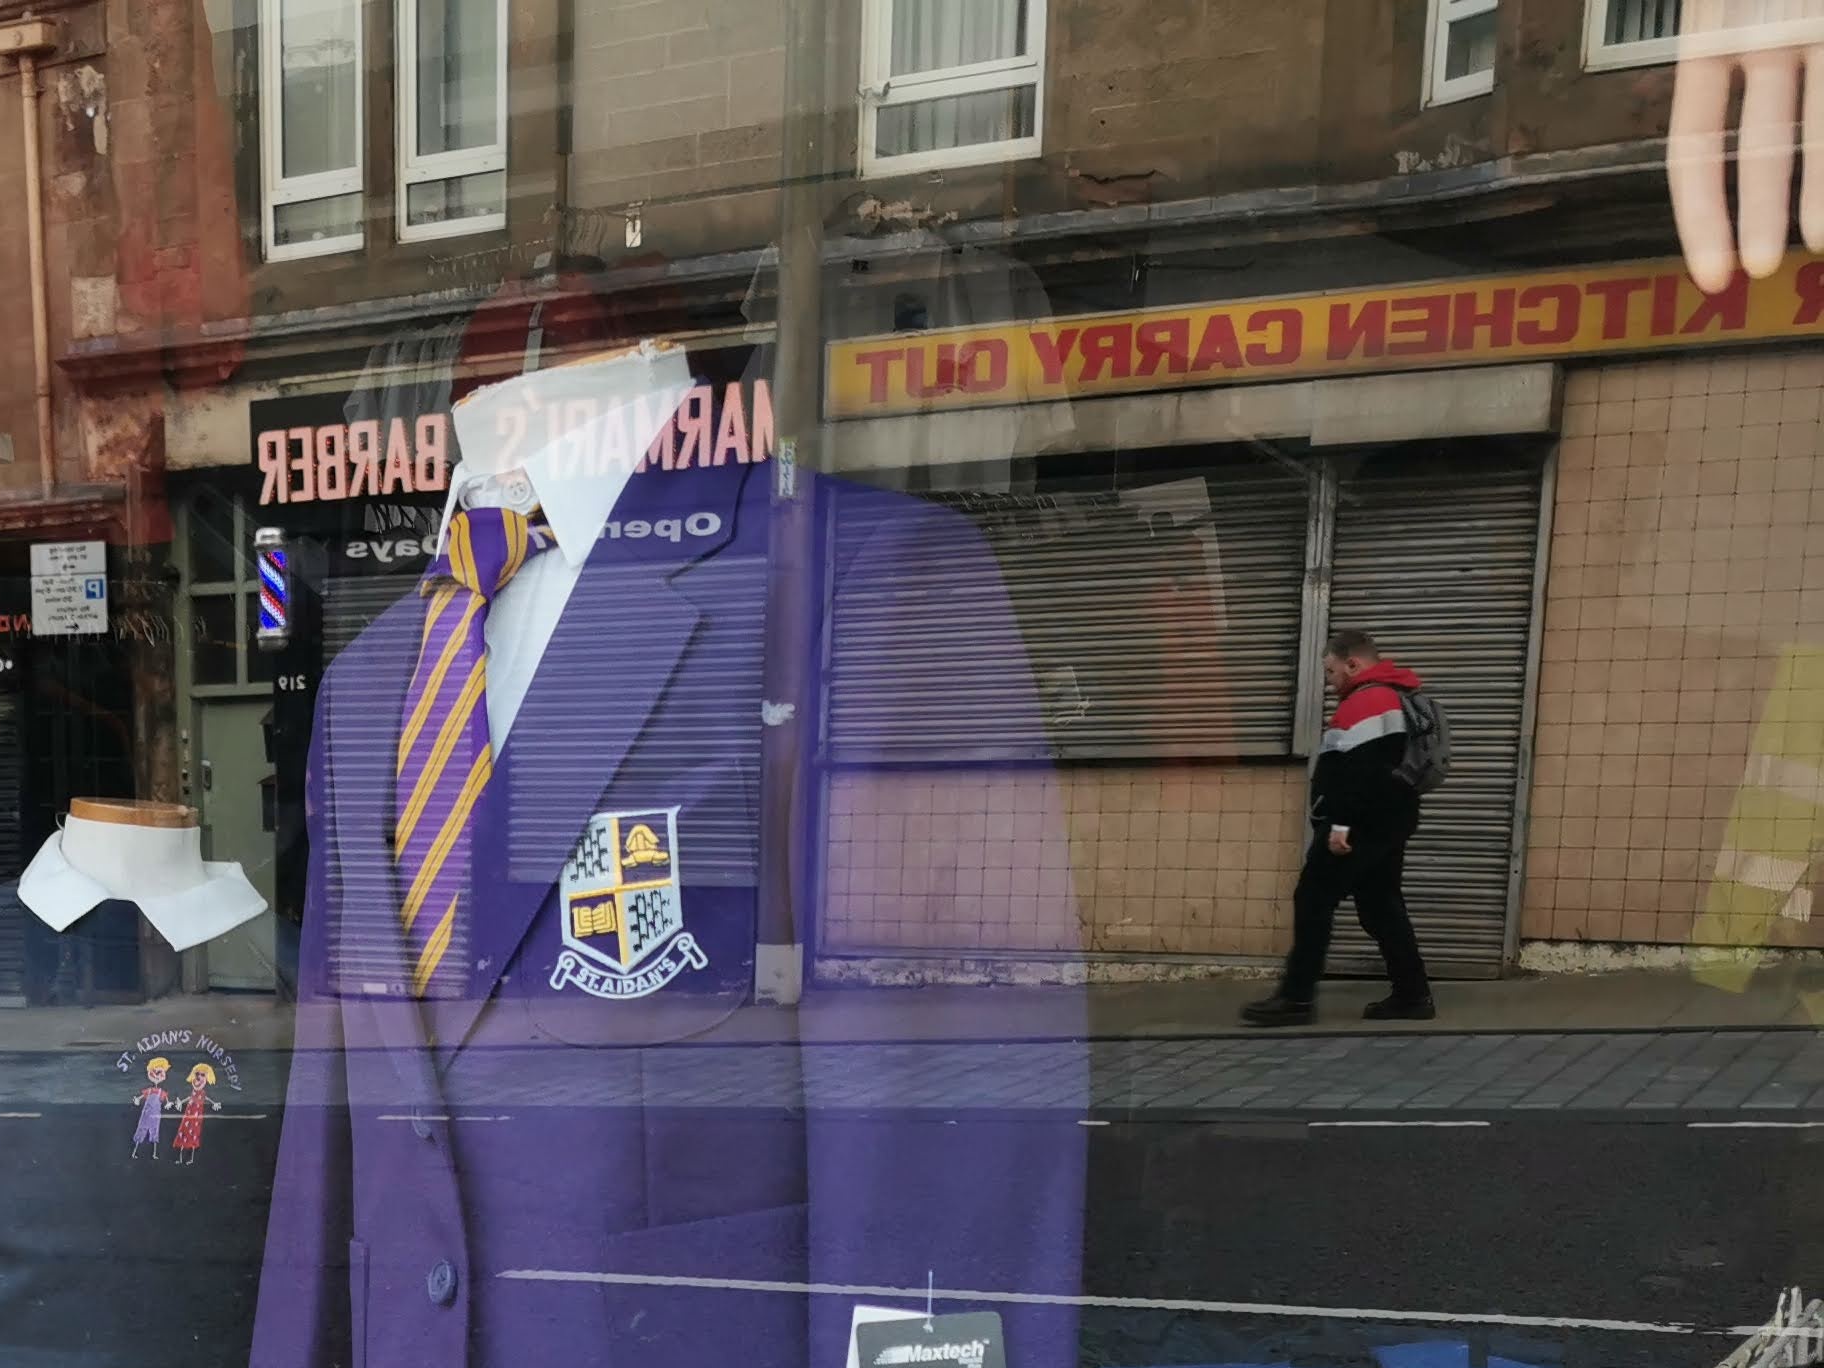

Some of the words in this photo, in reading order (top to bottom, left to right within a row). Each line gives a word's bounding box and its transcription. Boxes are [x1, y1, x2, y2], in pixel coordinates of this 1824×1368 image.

[136, 1029, 193, 1054] AIDAN'S
[196, 1034, 242, 1091] NURSERY
[905, 1340, 985, 1362] Maxtech
